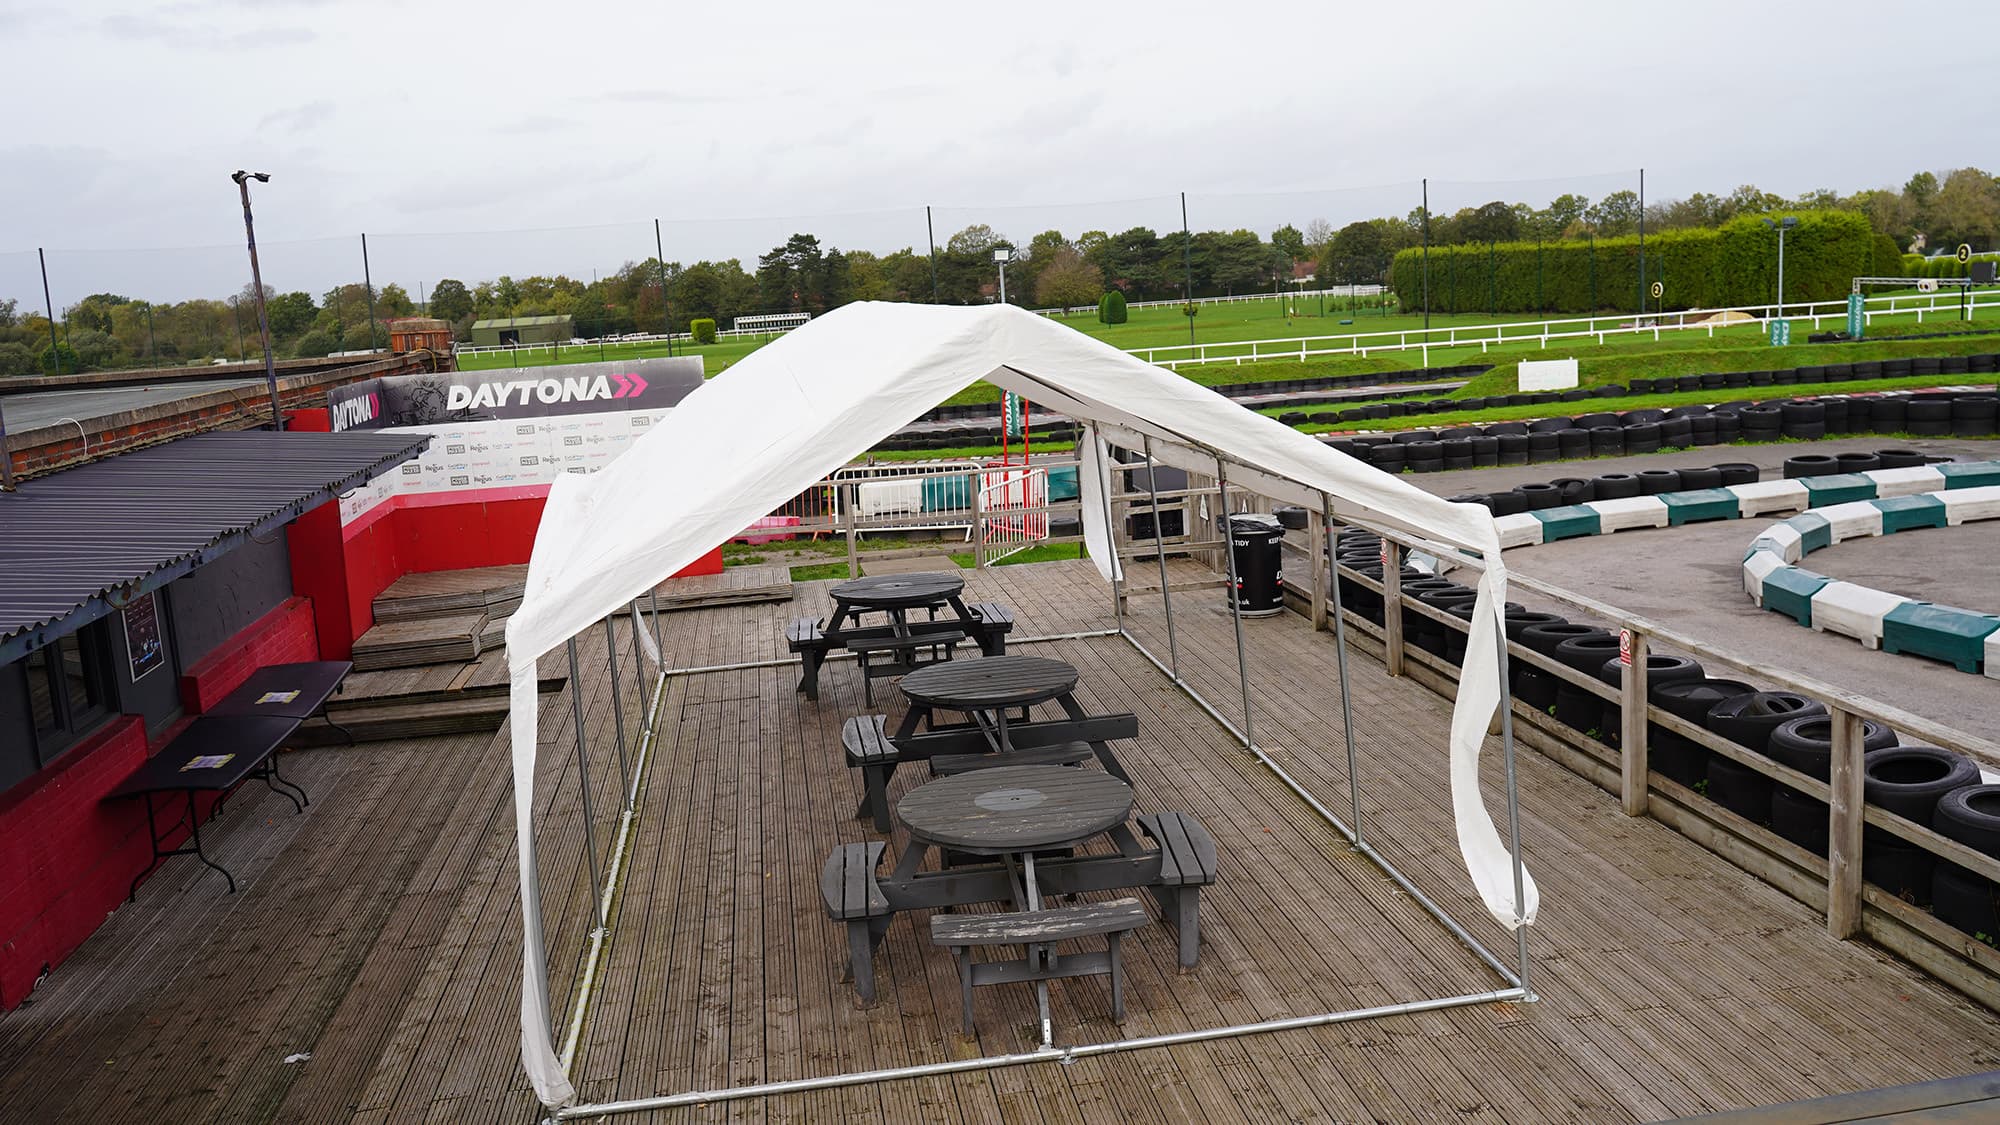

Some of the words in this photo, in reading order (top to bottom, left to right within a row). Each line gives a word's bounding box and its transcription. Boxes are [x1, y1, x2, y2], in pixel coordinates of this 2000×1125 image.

[447, 375, 613, 411] DAYTONA
[332, 394, 372, 432] DAYTONA
[425, 463, 444, 473] Regus
